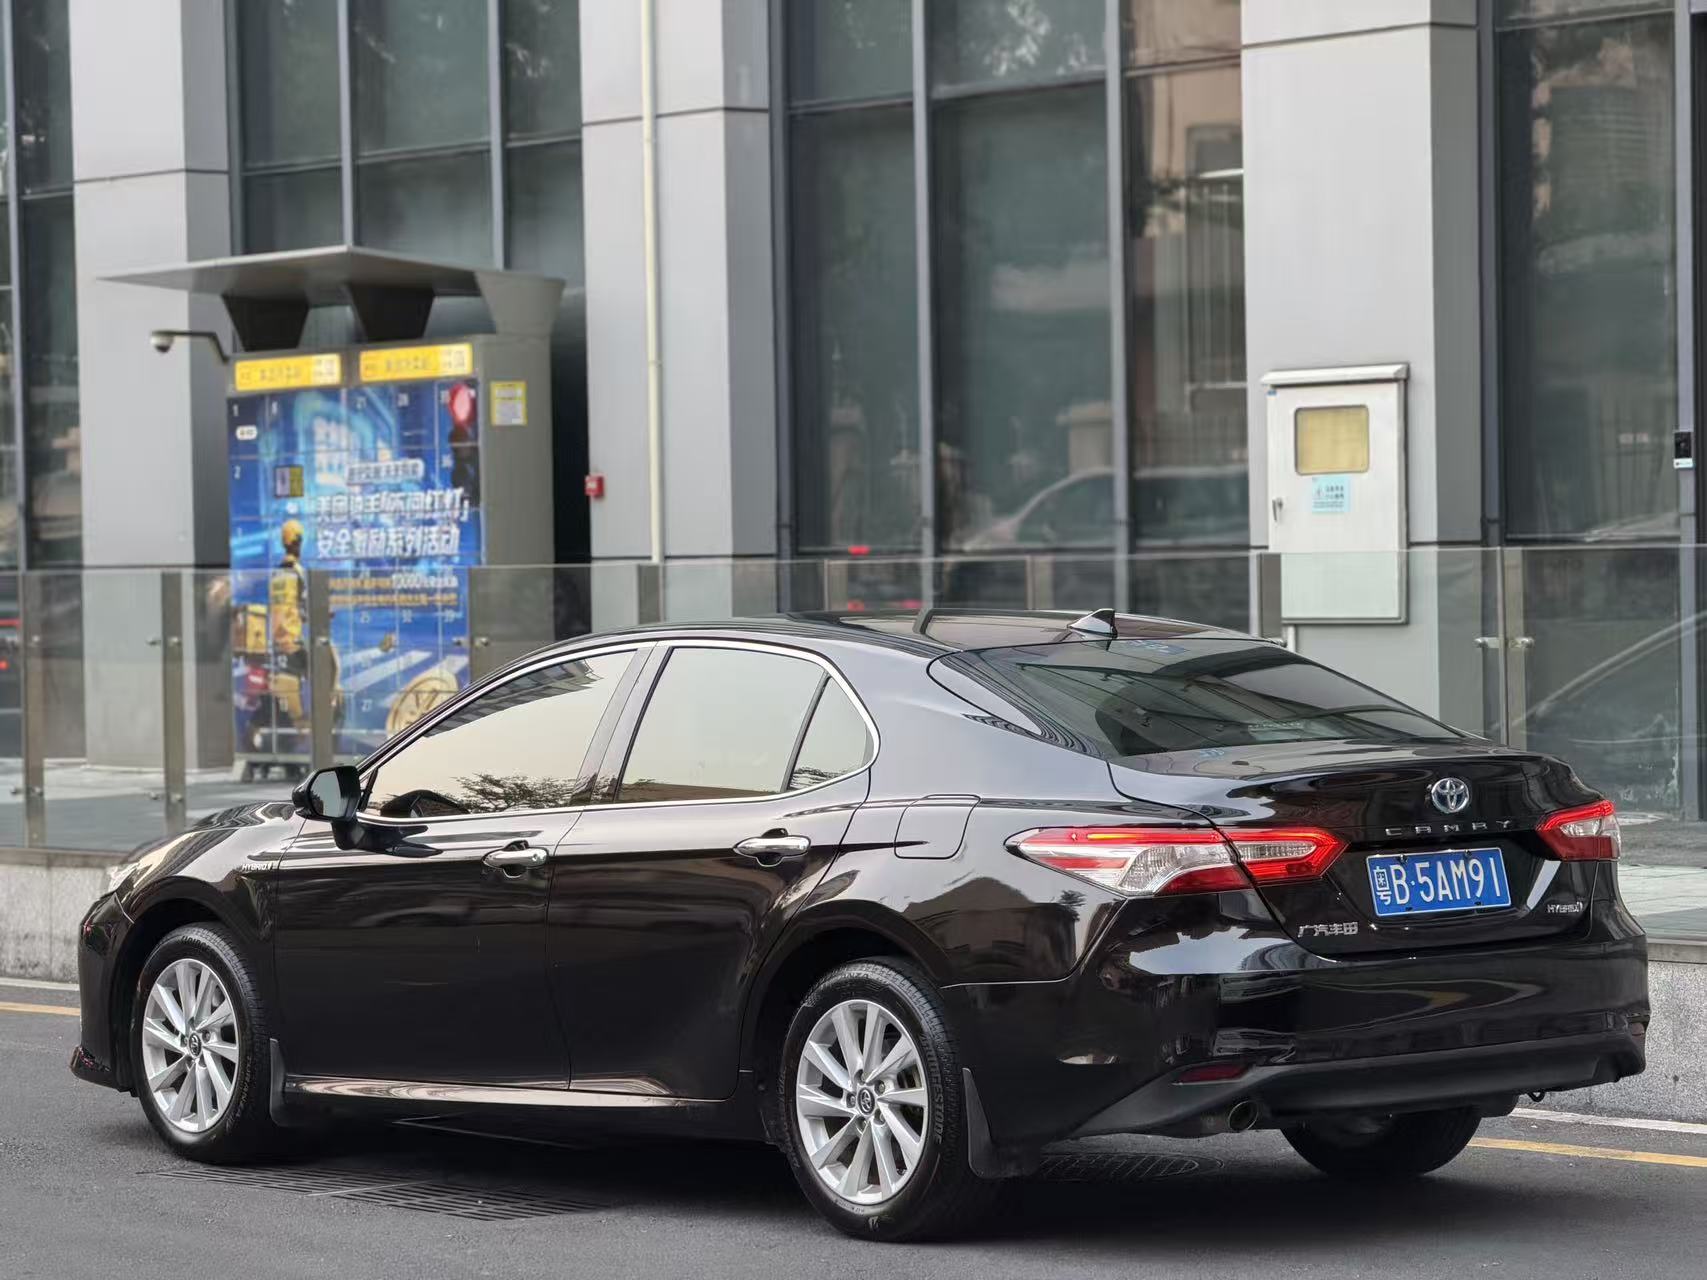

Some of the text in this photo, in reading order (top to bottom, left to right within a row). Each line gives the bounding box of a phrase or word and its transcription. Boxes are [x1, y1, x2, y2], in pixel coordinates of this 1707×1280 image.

[1385, 819, 1510, 836] CAMRY
[1297, 921, 1359, 938] 广汽丰田
